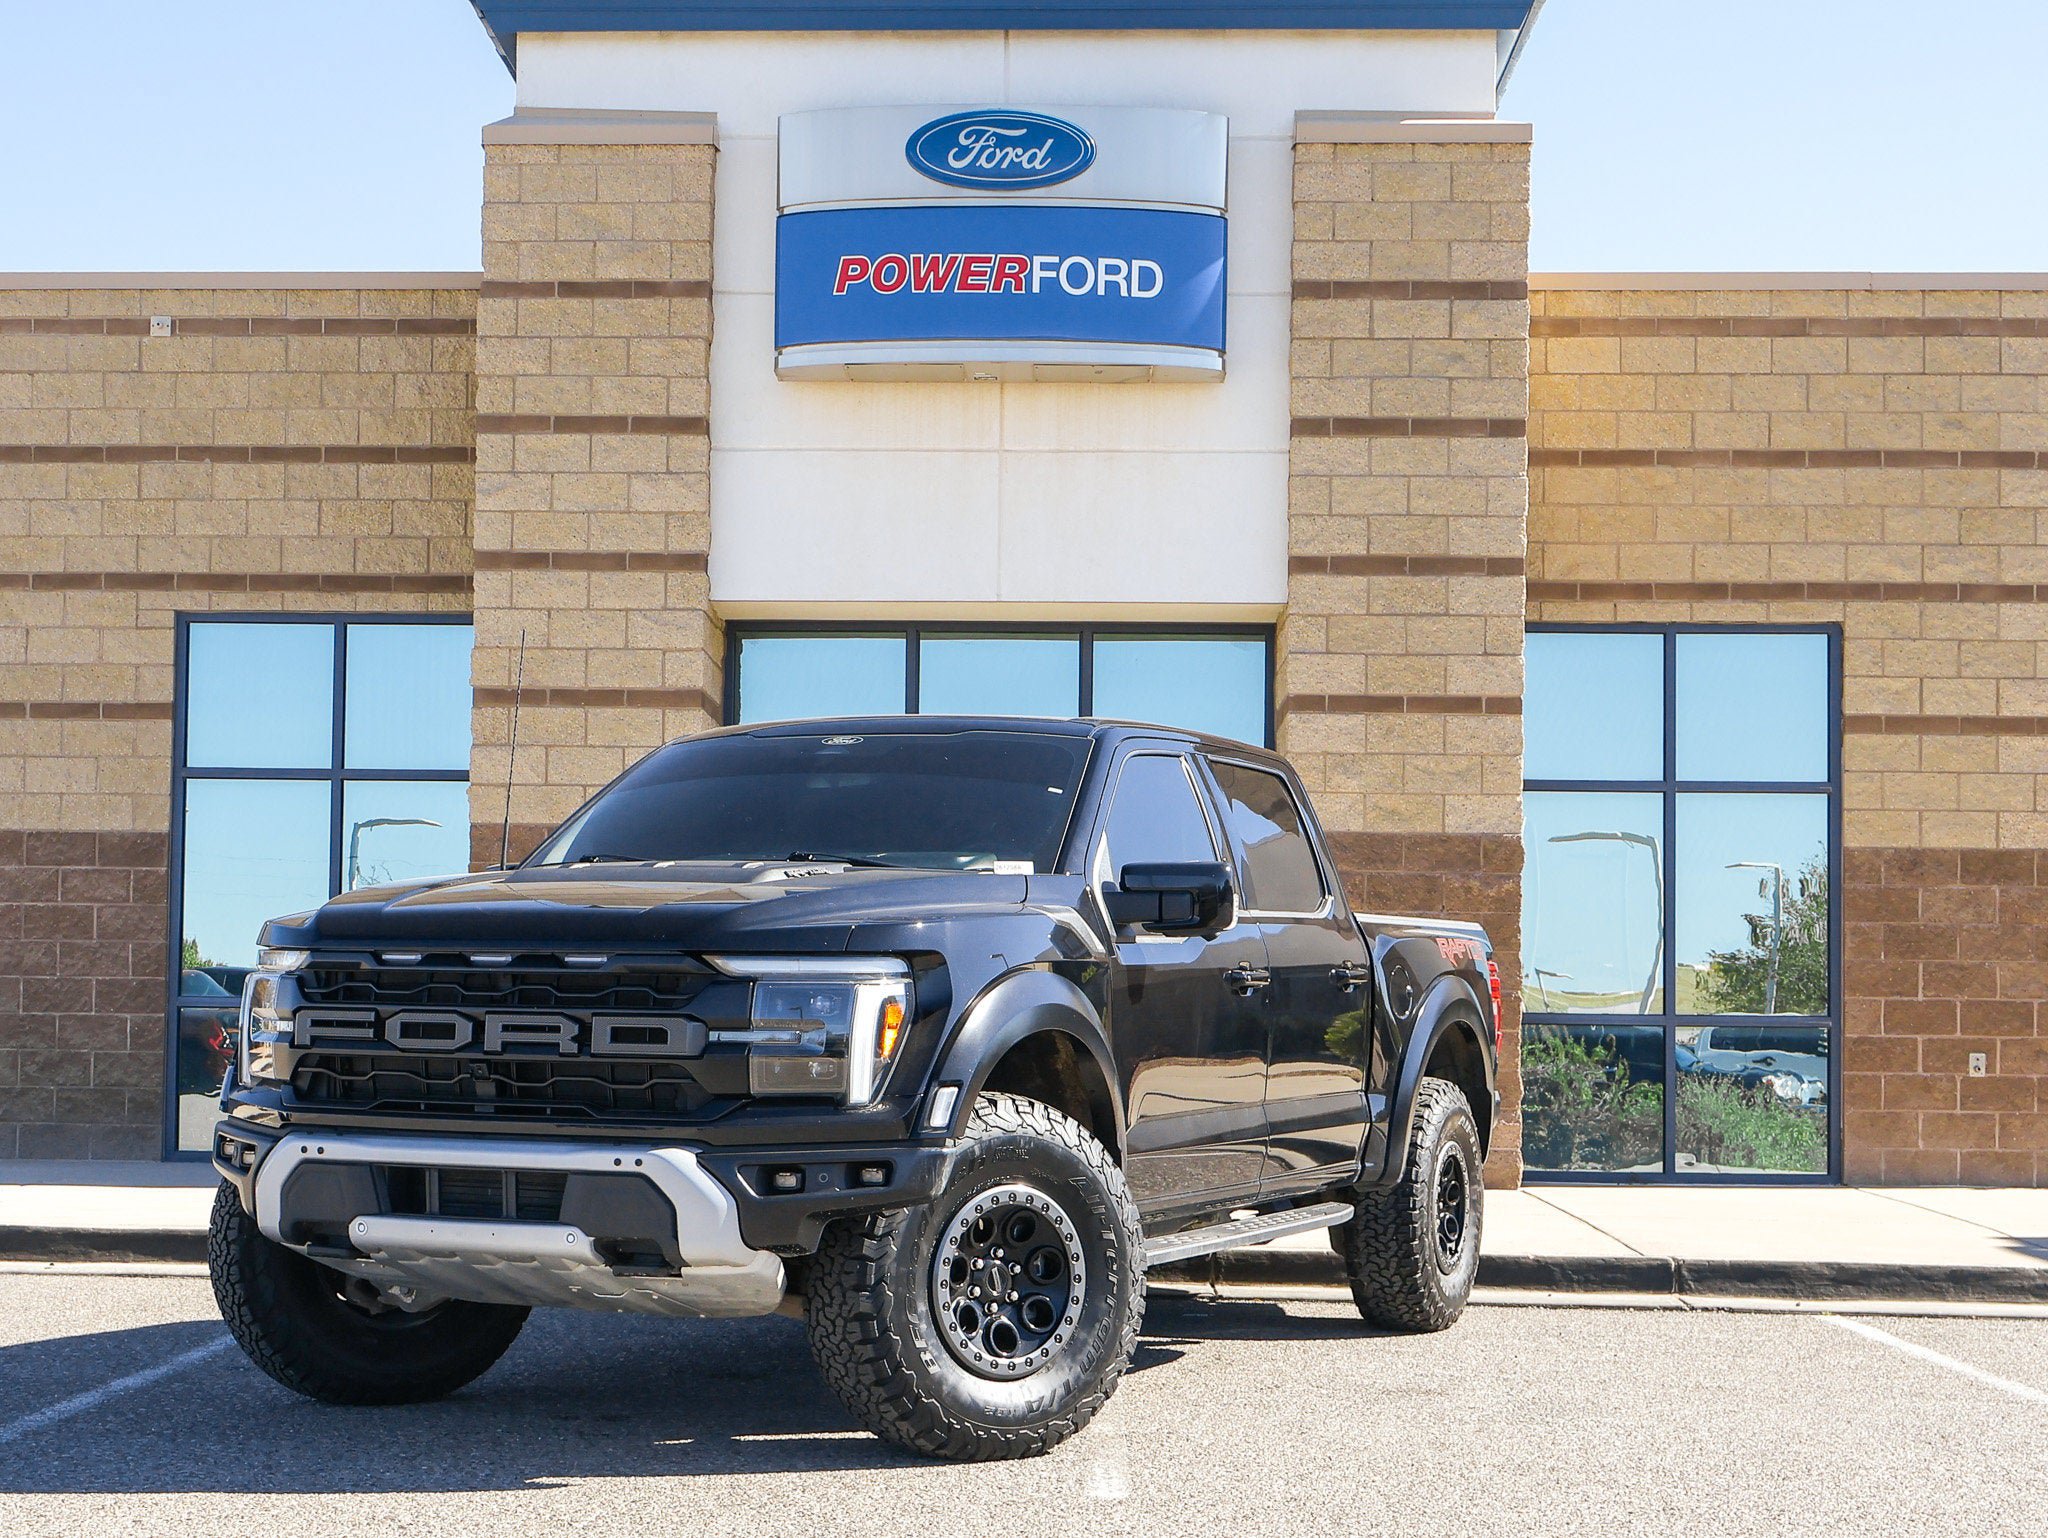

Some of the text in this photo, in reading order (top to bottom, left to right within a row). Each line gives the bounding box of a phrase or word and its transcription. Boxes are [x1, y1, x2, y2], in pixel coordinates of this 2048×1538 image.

[948, 125, 1054, 170] Ford
[832, 253, 1164, 299] POWERFORD
[295, 1009, 707, 1057] FORD
